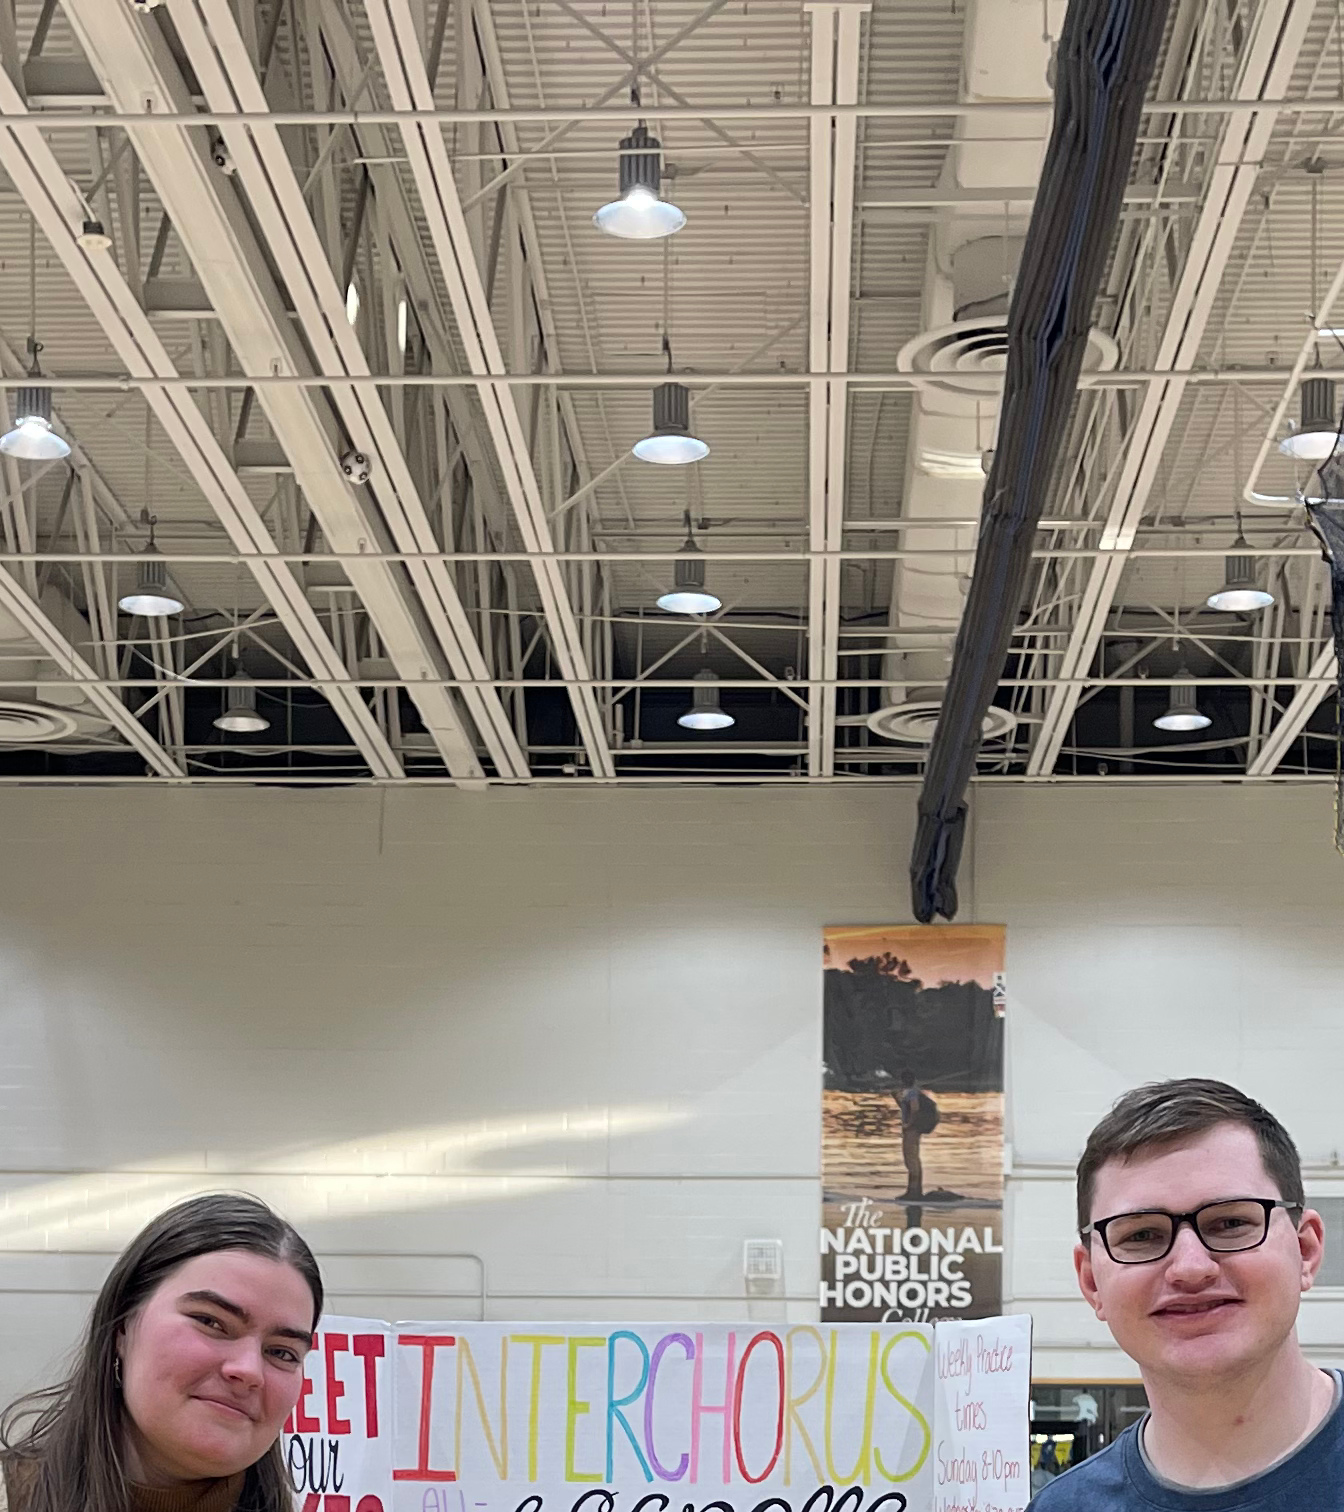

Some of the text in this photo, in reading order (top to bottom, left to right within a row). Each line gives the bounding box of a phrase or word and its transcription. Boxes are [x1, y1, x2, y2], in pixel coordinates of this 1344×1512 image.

[841, 1198, 883, 1227] The
[820, 1227, 1004, 1254] NATIONAL
[835, 1254, 964, 1281] PUBLIC
[820, 1281, 973, 1308] HONORS
[284, 1333, 385, 1438] EET
[937, 1334, 1013, 1396] Weekly Practice
[392, 1330, 933, 1485] INTERCHORUS
[955, 1391, 986, 1431] times
[288, 1434, 345, 1493] our
[938, 1440, 978, 1502] Sunday
